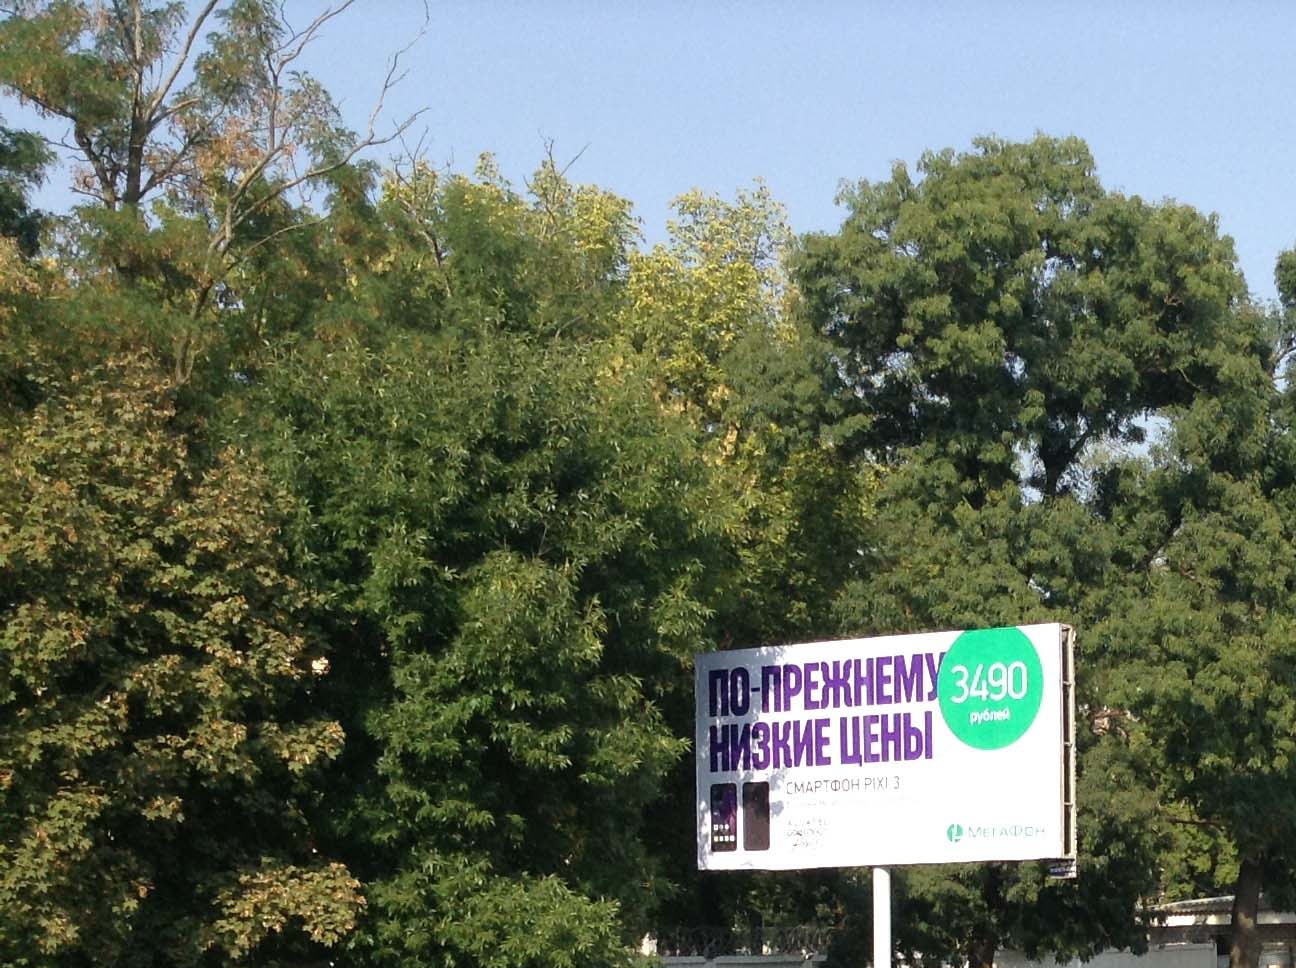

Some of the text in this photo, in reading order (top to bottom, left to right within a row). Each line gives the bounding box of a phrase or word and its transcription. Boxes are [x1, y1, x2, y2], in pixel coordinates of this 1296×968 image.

[708, 652, 946, 718] ПО-ПРЕЖНЕМУ
[950, 660, 1028, 704] 3490
[968, 706, 1011, 726] рублей
[709, 710, 934, 773] НИЗКИЕ ЦЕНЫ
[786, 775, 900, 795] СМАРТФОН PIXI 3
